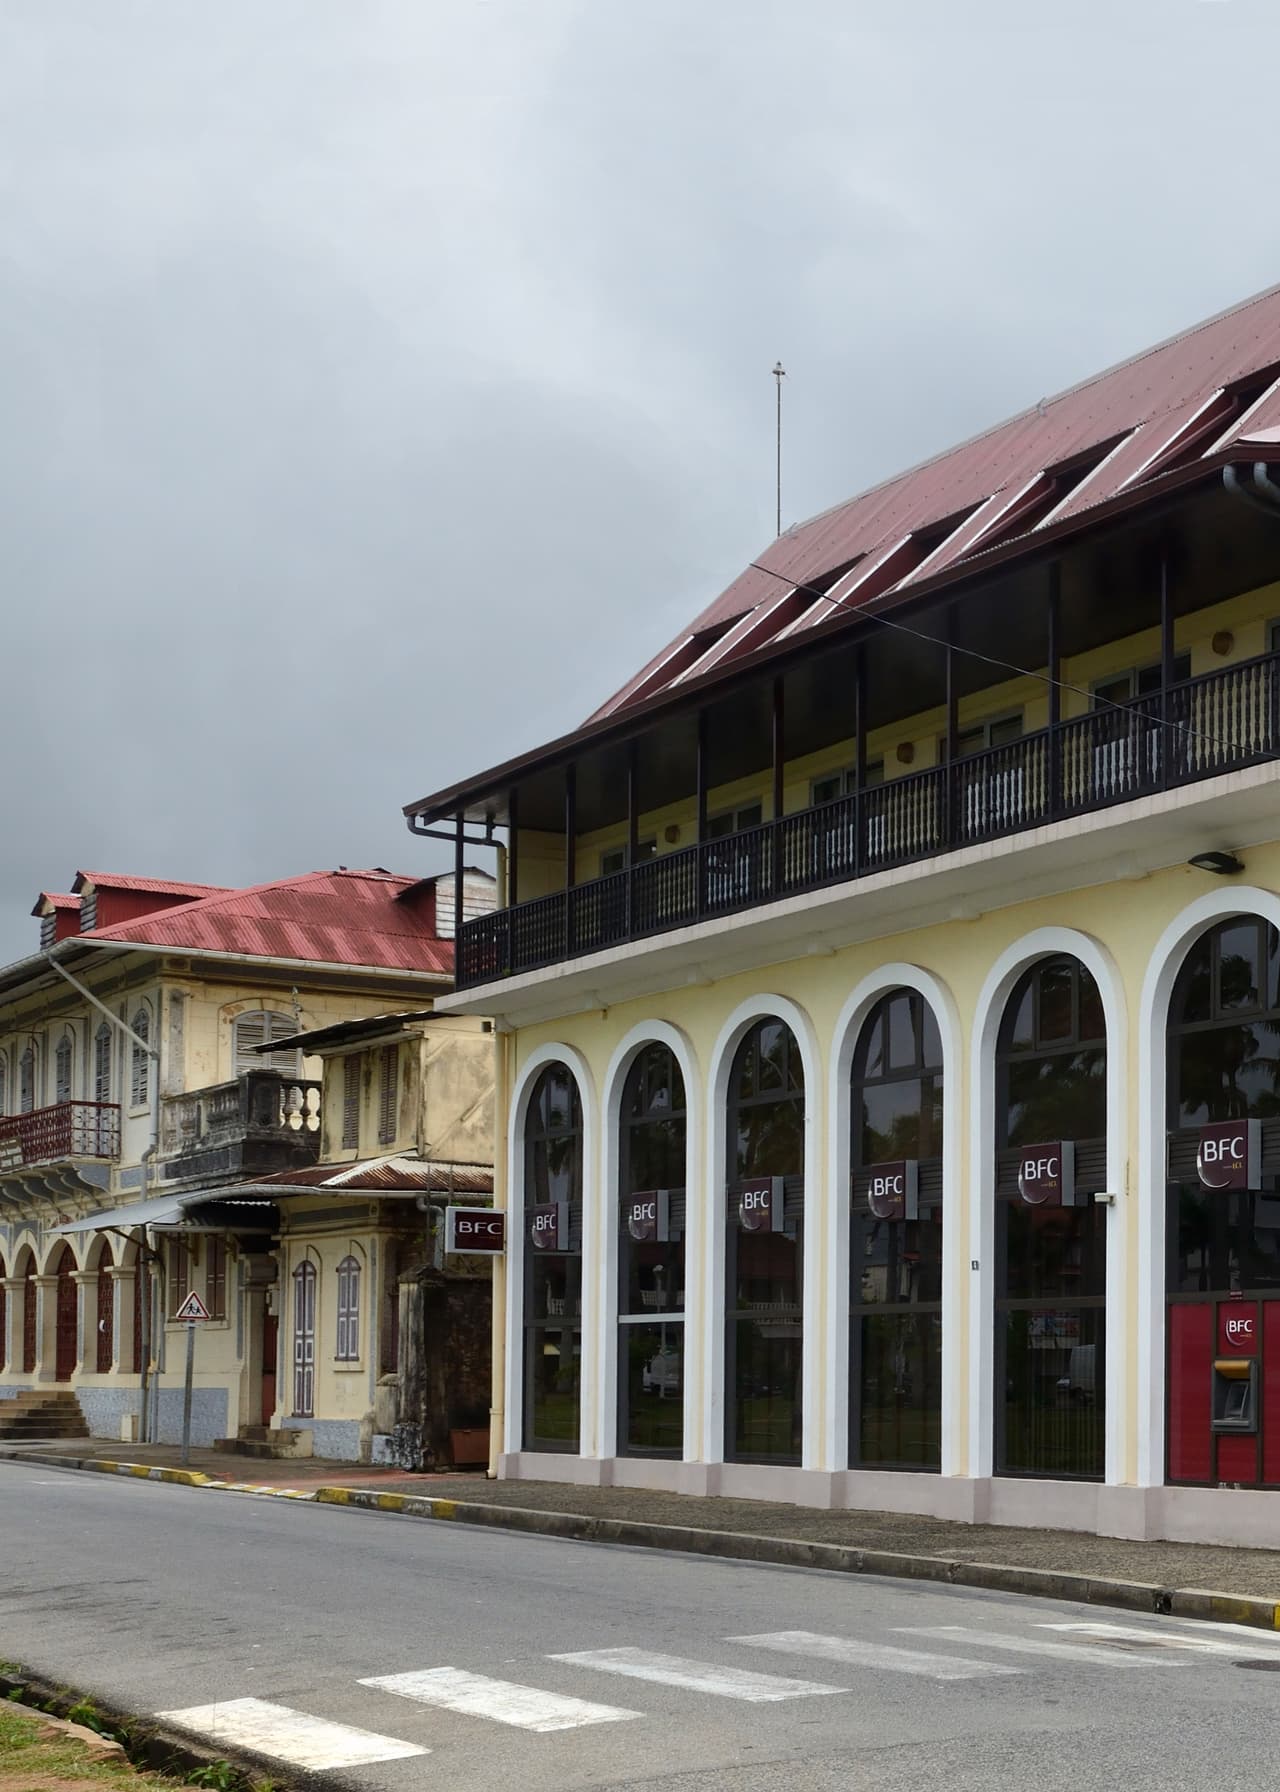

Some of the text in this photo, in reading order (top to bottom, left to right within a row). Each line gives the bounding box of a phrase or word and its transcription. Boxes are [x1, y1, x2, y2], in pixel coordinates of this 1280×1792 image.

[1203, 1136, 1244, 1162] BFC
[1024, 1157, 1058, 1180] BFC
[873, 1175, 903, 1196] BFC
[744, 1190, 769, 1209] BFC
[633, 1202, 656, 1221] BFC
[458, 1221, 502, 1235] BFC
[536, 1214, 557, 1231] BFC
[1229, 1319, 1253, 1333] BFC
